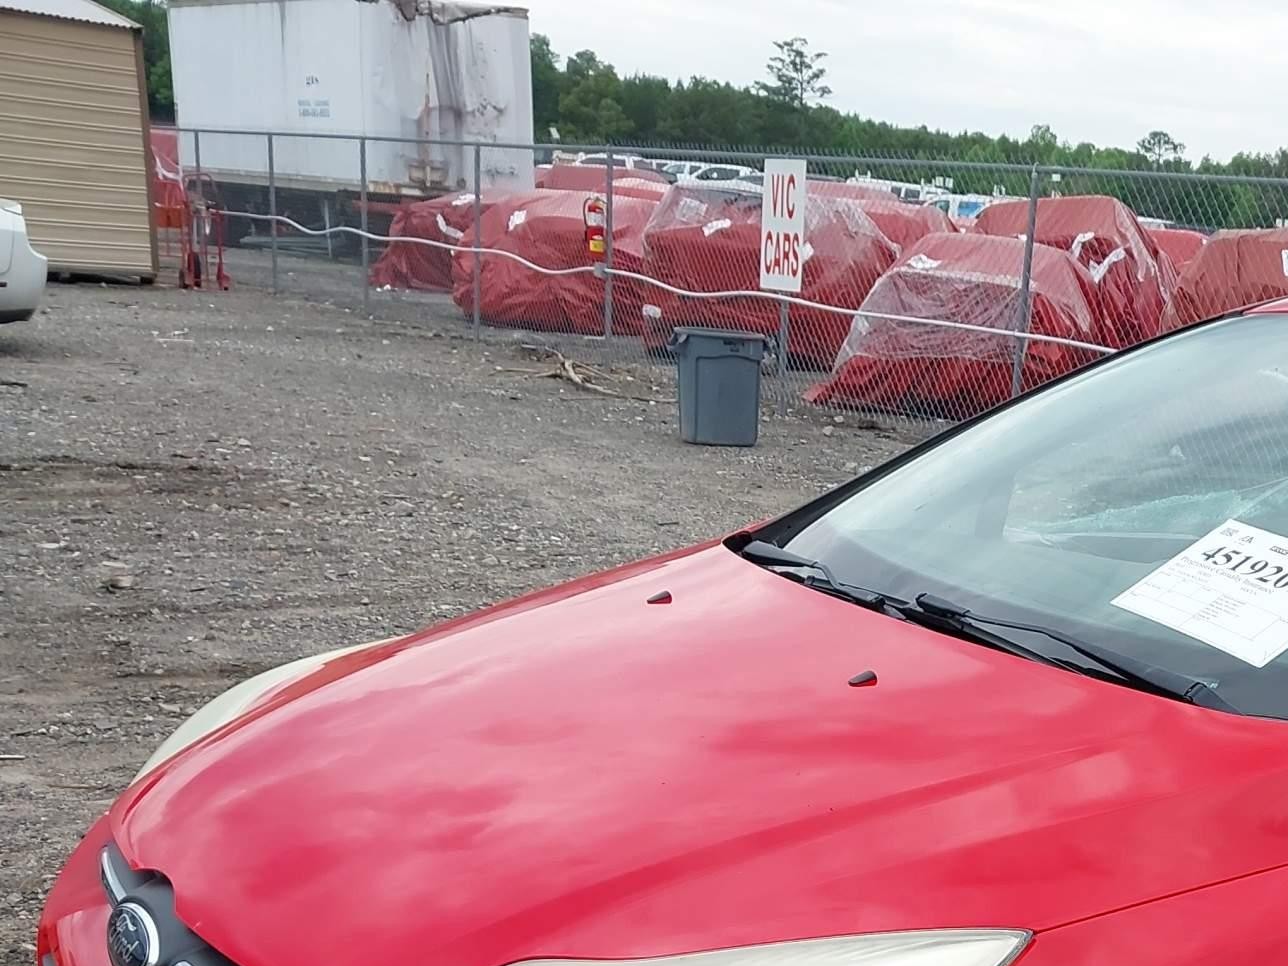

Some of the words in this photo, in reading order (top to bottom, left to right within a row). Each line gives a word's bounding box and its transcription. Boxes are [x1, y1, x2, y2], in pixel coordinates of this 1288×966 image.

[771, 173, 796, 219] VIC
[764, 230, 799, 278] CARS
[109, 912, 140, 963] Ford
